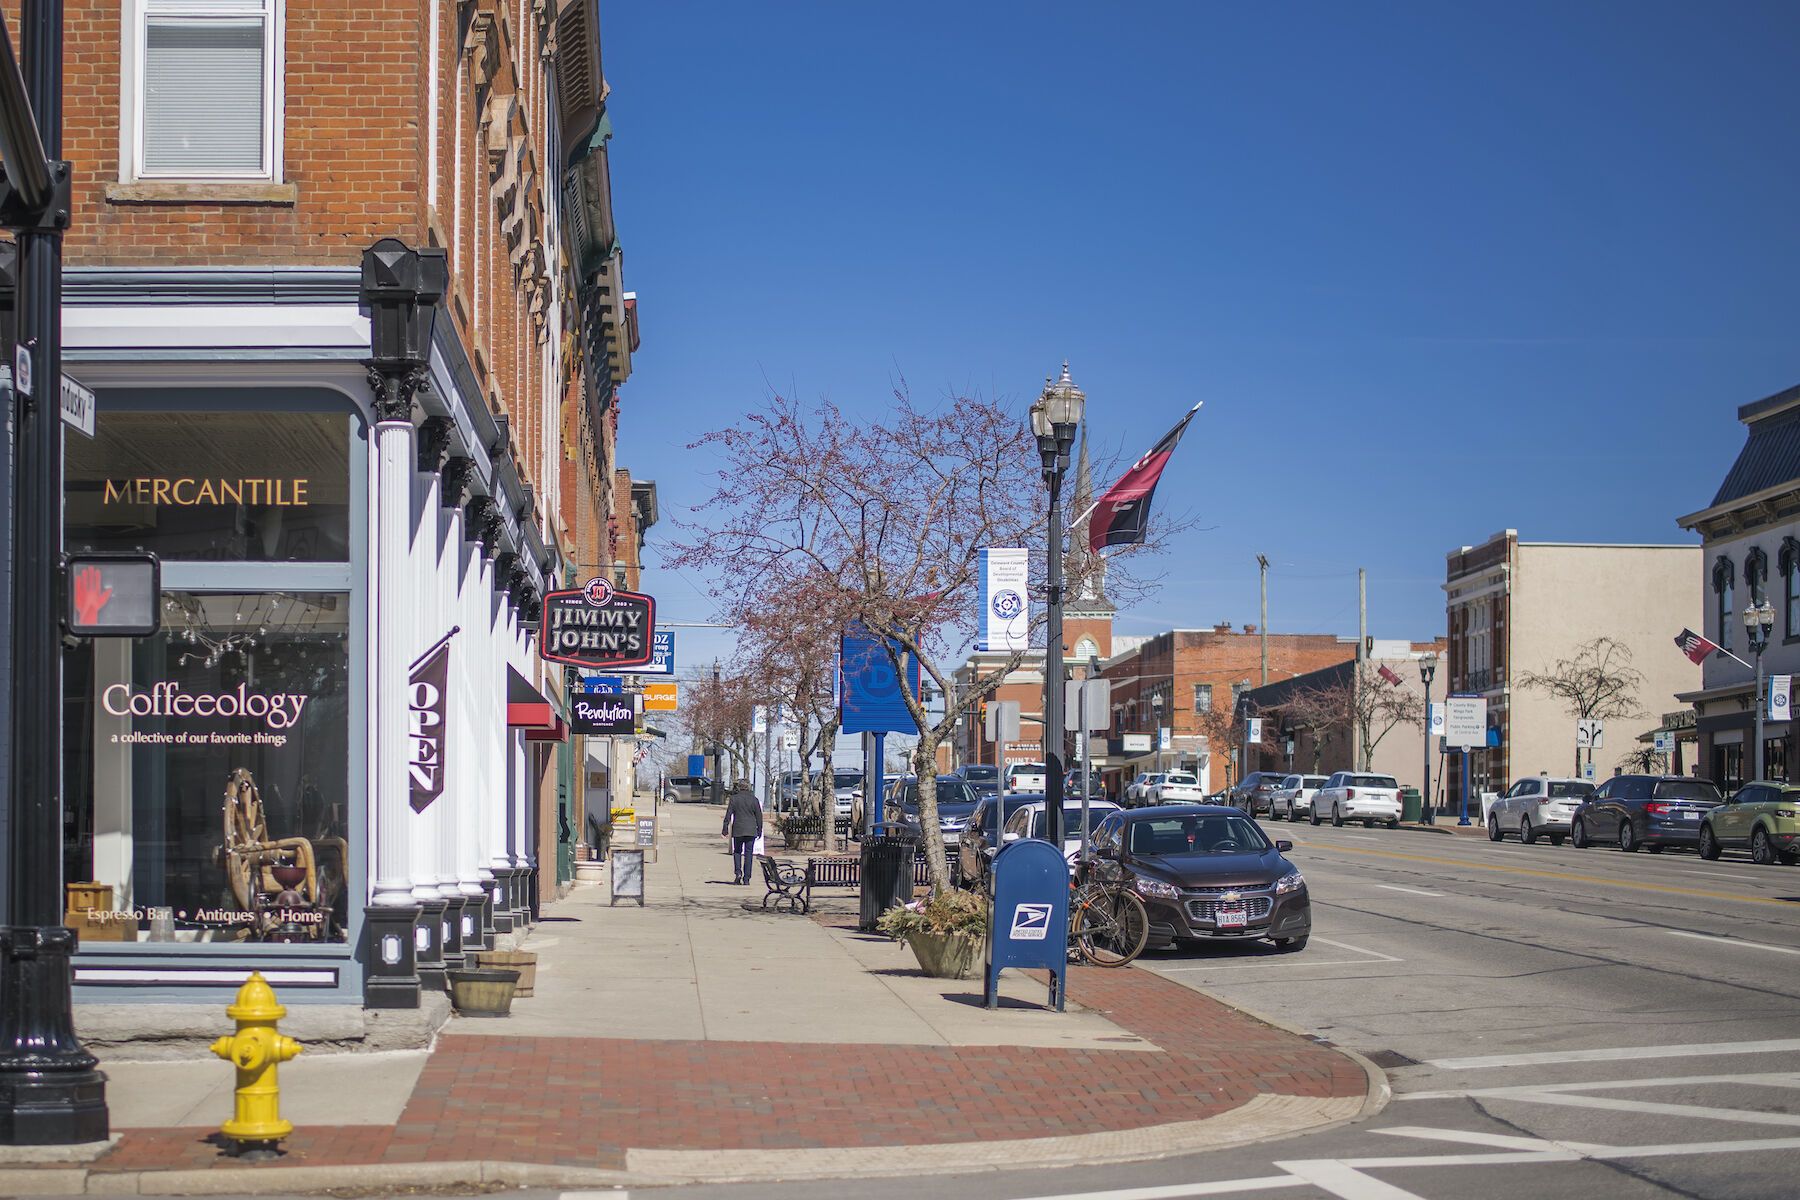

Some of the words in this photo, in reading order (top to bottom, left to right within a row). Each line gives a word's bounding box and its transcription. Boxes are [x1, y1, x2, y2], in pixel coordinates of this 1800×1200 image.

[103, 478, 309, 506] MERCANTILE
[552, 607, 642, 629] JIMMY
[551, 629, 640, 652] JOHN'S
[102, 681, 308, 729] Coffeeology
[574, 701, 632, 722] Revolution
[111, 734, 118, 743] a
[120, 731, 173, 743] collective
[175, 731, 188, 743] of
[189, 734, 208, 743] our
[210, 731, 252, 743] favorite
[253, 732, 287, 747] things
[408, 681, 441, 792] OPEN
[87, 907, 144, 924] Espresso
[146, 908, 170, 920] Bar
[194, 908, 255, 924] Antiques
[280, 909, 323, 923] Home
